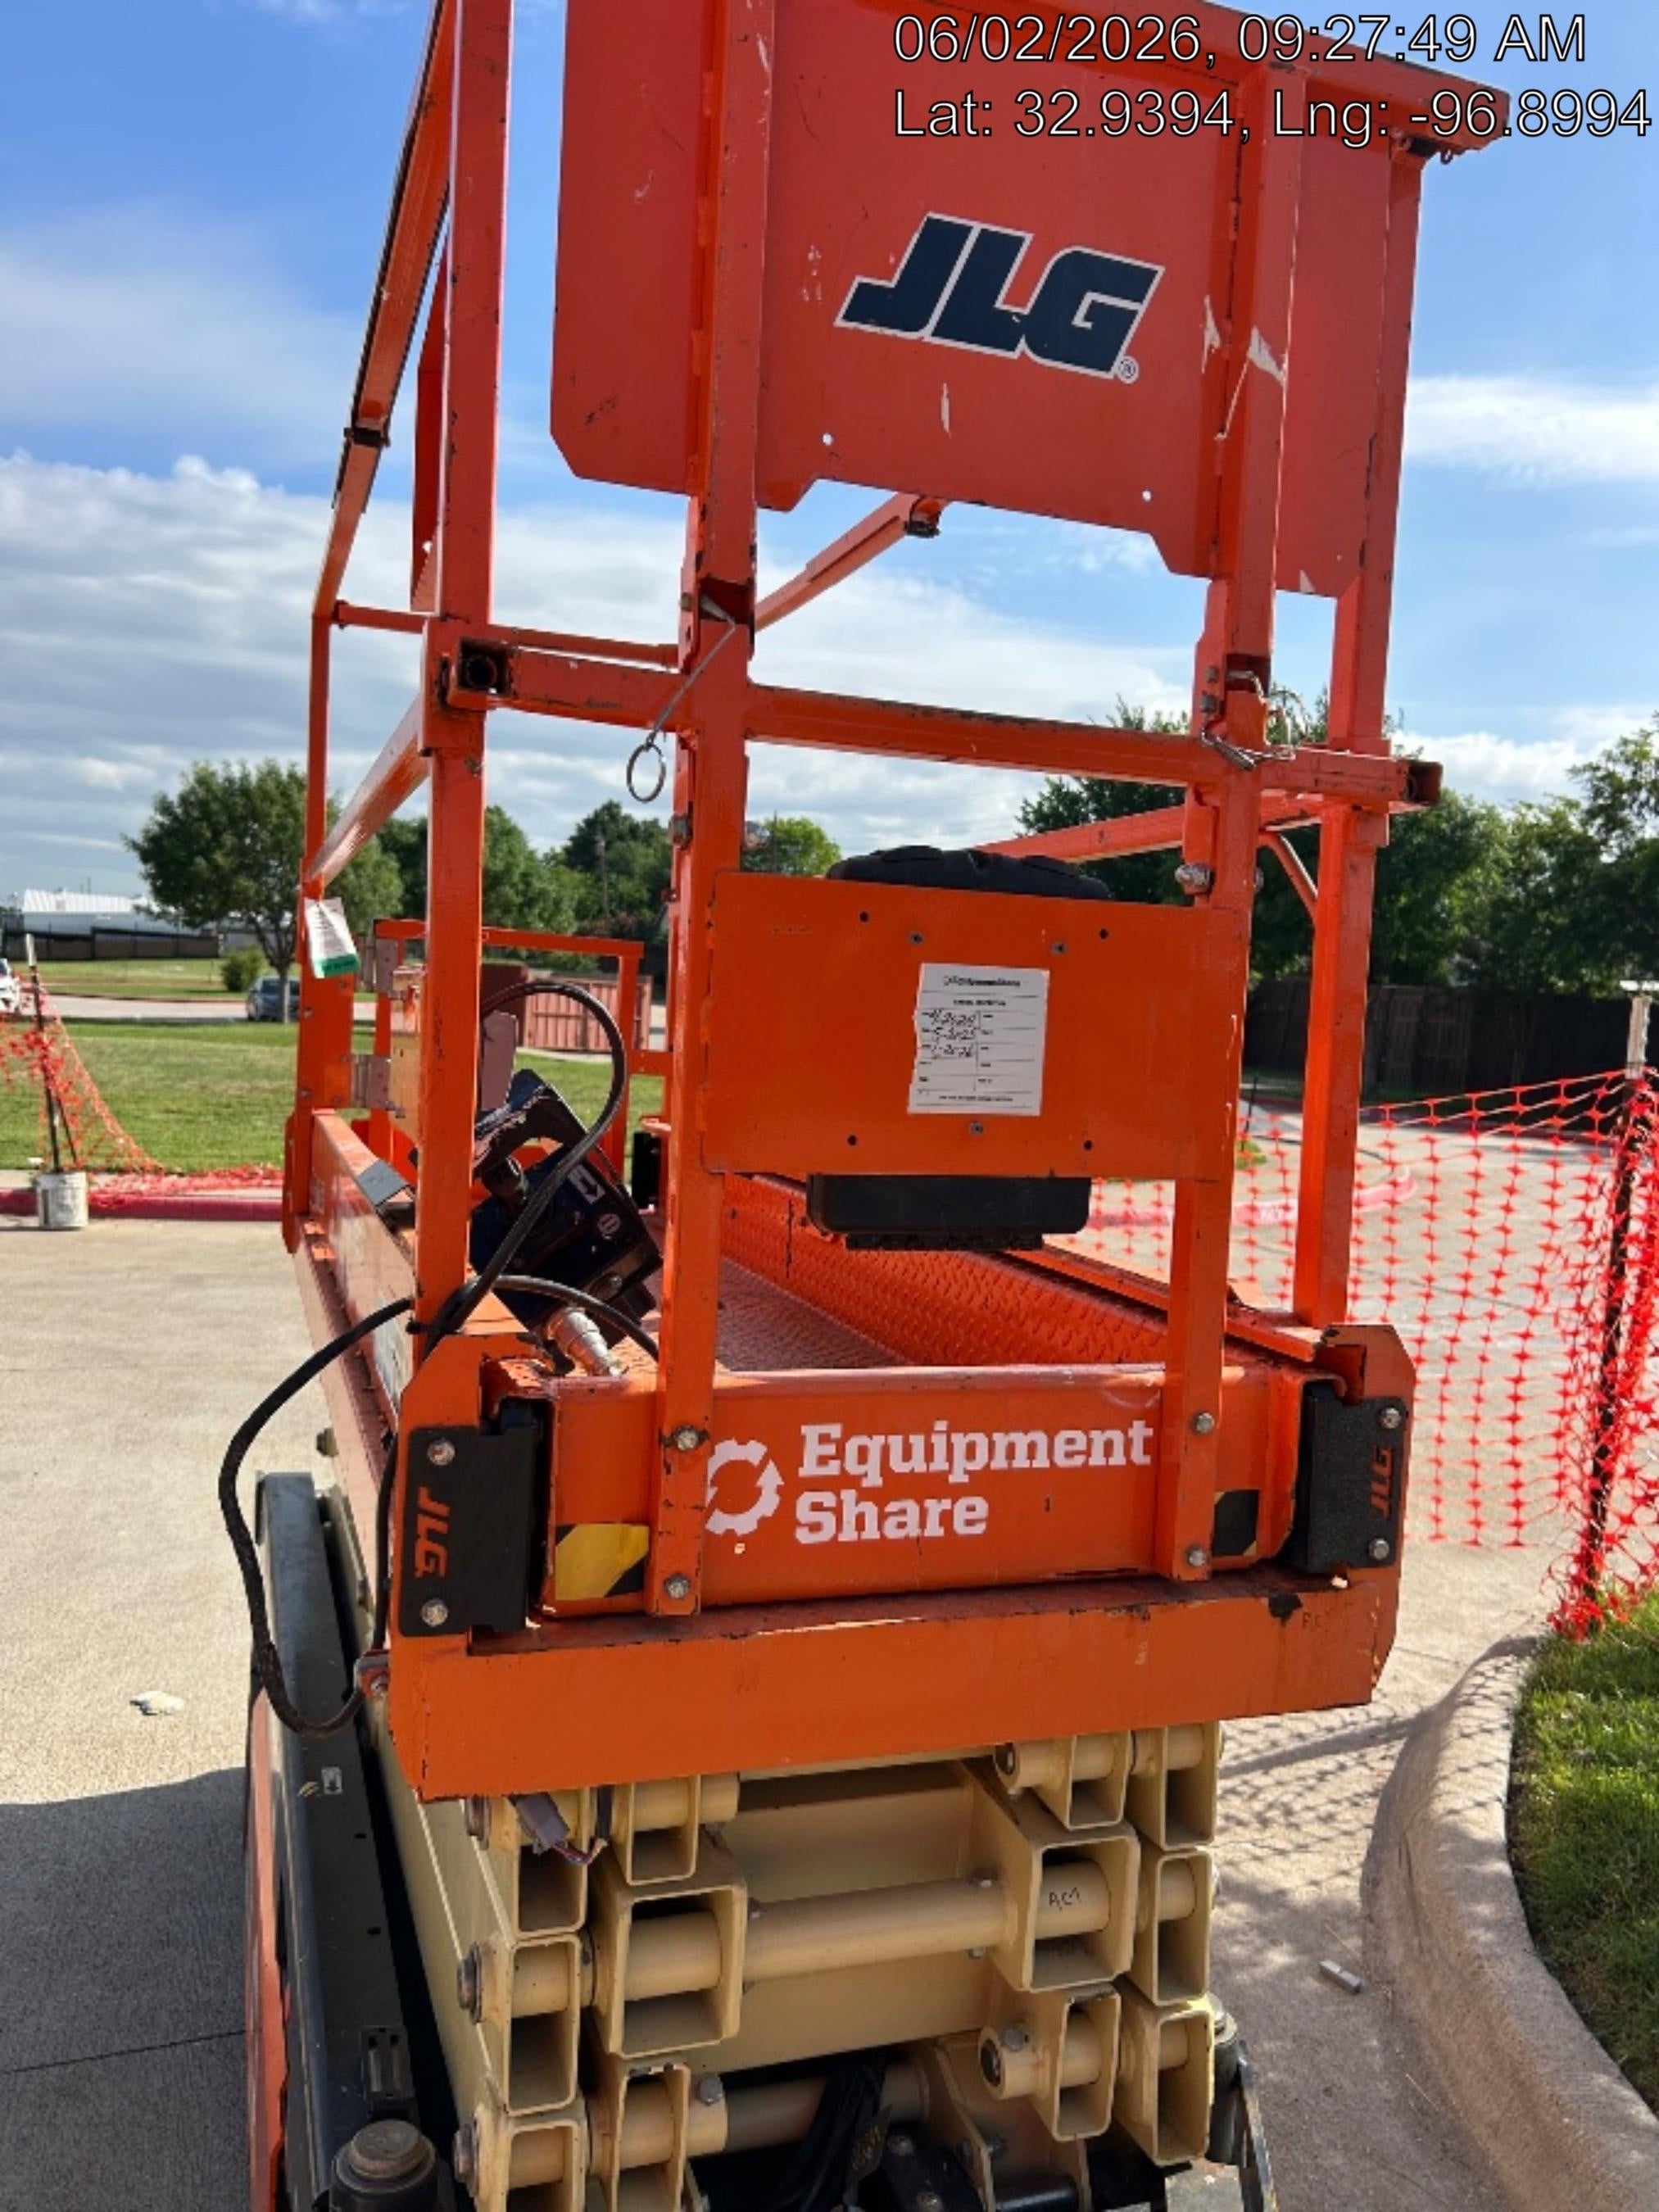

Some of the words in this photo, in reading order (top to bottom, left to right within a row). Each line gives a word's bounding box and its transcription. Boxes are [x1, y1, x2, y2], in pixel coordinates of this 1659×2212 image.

[834, 211, 1166, 380] JLG
[798, 1420, 1154, 1487] Equipment
[1370, 1445, 1394, 1521] JLG
[415, 1485, 450, 1580] JLG
[795, 1489, 989, 1544] Share
